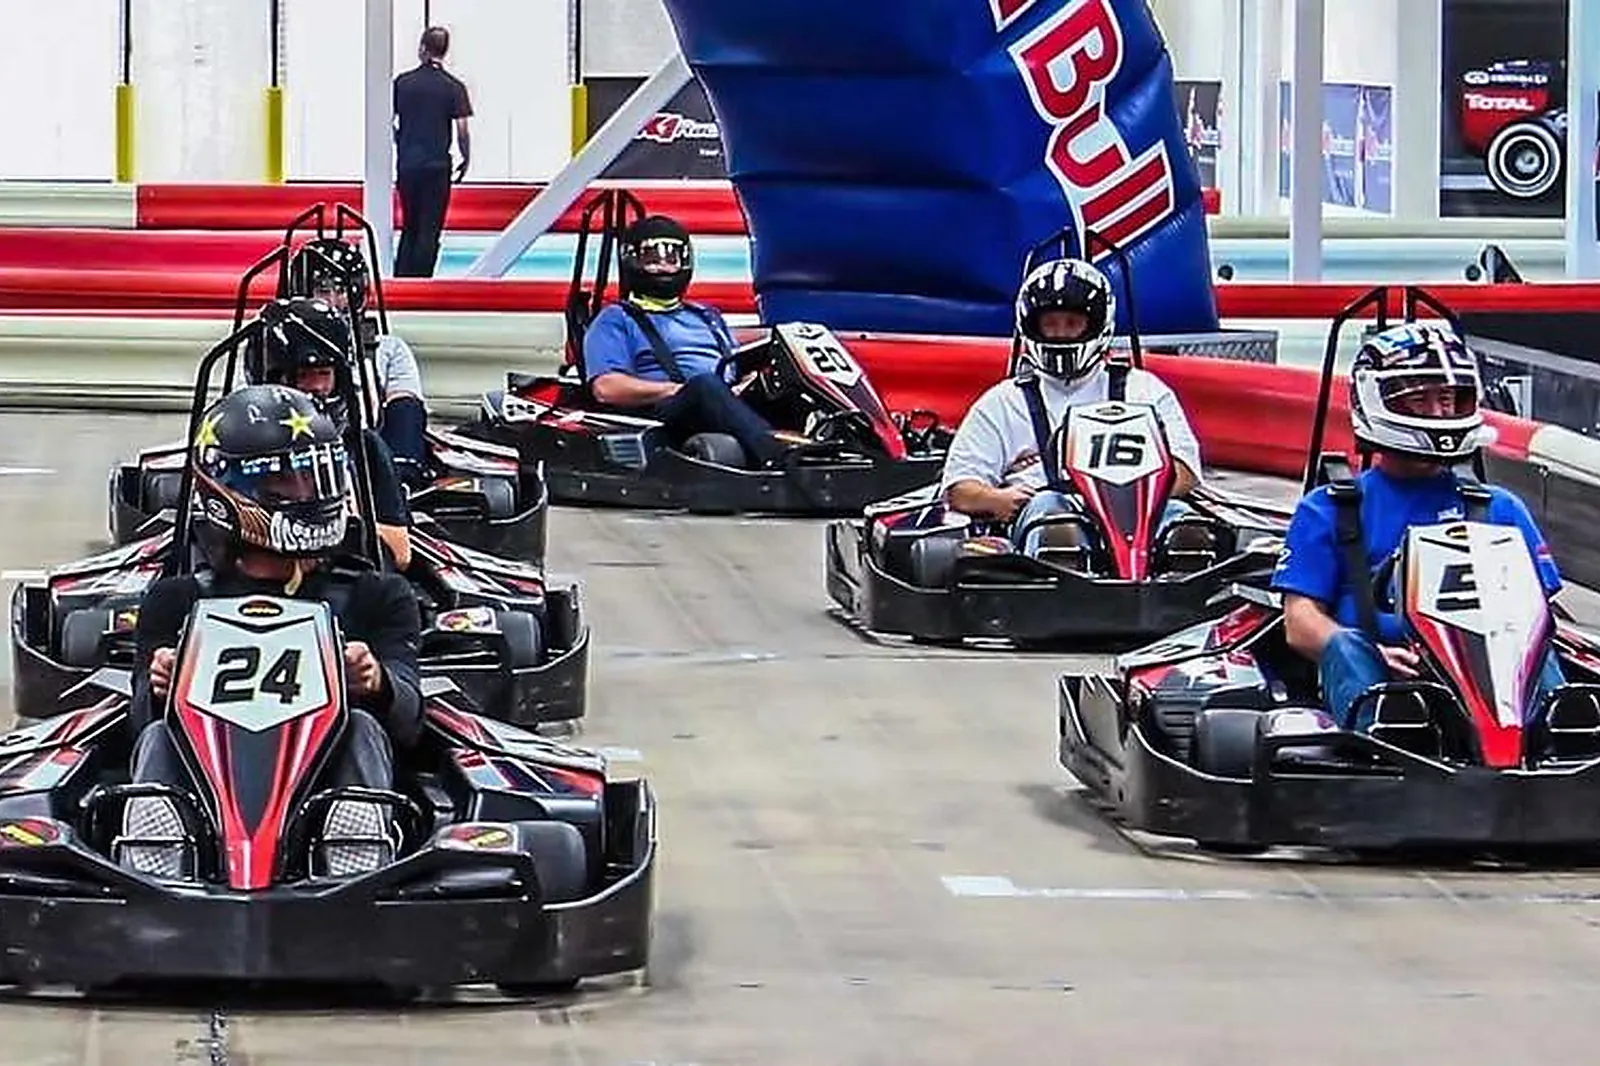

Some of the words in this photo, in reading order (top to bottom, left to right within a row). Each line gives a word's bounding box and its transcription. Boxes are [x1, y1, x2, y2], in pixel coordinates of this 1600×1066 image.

[1464, 93, 1536, 111] TOTAL
[1010, 0, 1173, 263] Bull
[805, 346, 854, 374] 20
[1088, 433, 1146, 469] 16
[1439, 435, 1455, 451] 3
[210, 646, 302, 705] 24
